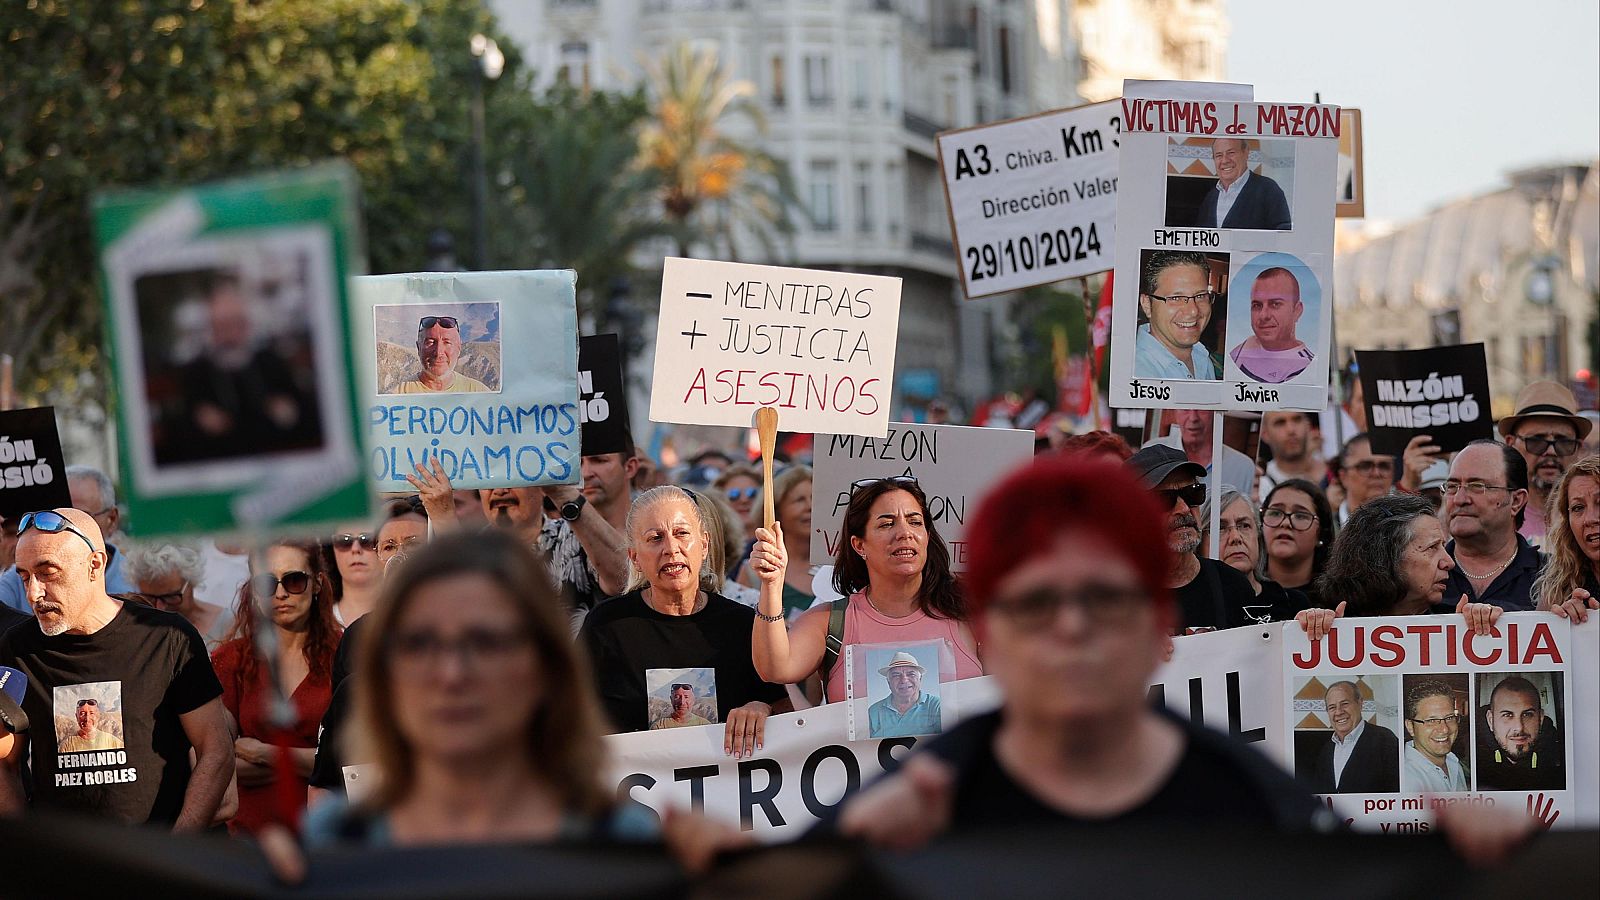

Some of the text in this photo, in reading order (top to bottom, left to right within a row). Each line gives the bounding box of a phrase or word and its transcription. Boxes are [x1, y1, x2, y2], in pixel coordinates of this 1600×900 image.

[1225, 104, 1247, 134] de
[1257, 105, 1341, 137] MAZON
[1006, 149, 1058, 170] Chiva.
[1061, 126, 1103, 159] Km
[982, 186, 1070, 219] Dirección
[967, 222, 1101, 281] 29/10/2024
[1154, 229, 1220, 247] EMETERIO
[725, 281, 874, 319] MENTIRAS
[719, 317, 872, 366] JUSTICIA
[683, 367, 881, 416] ASESINOS
[1234, 381, 1280, 403] JAVIER
[1376, 371, 1464, 402] MAZÓN
[369, 403, 577, 437] PERDONAMOS
[1371, 393, 1480, 429] DIMISSIÓ
[828, 430, 938, 465] MAZON
[1292, 623, 1564, 669] JUSTICIA
[57, 750, 127, 769] FERNANDO
[54, 767, 137, 787] PAEZ ROBLES
[1364, 798, 1396, 815] por
[1401, 794, 1424, 810] mi
